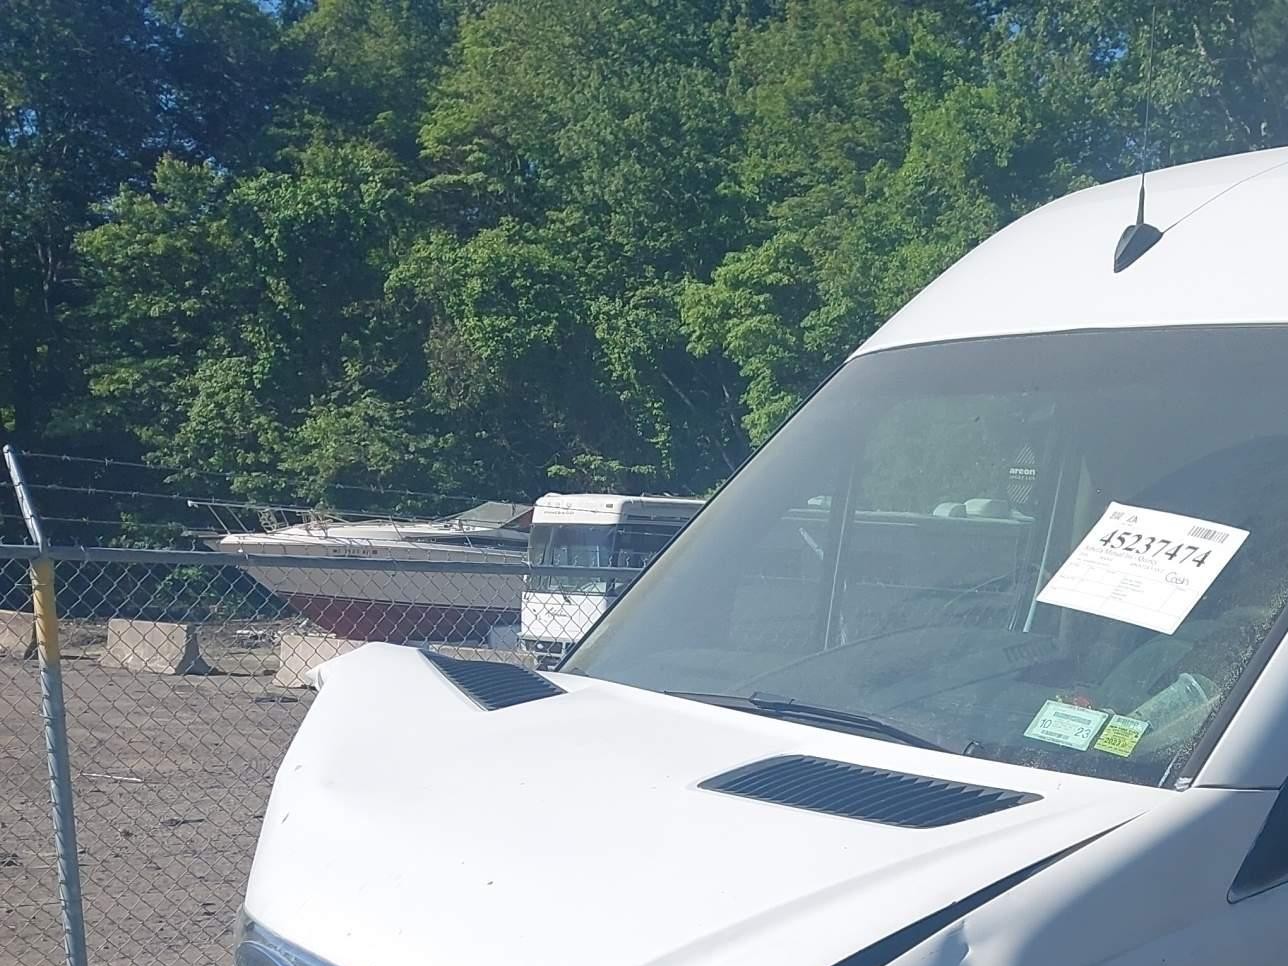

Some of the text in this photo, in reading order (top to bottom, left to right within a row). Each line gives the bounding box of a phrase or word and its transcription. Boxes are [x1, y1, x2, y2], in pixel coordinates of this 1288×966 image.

[1009, 467, 1036, 476] areon
[1099, 528, 1213, 568] 45237474
[1039, 718, 1053, 730] 10
[1074, 727, 1092, 739] 23
